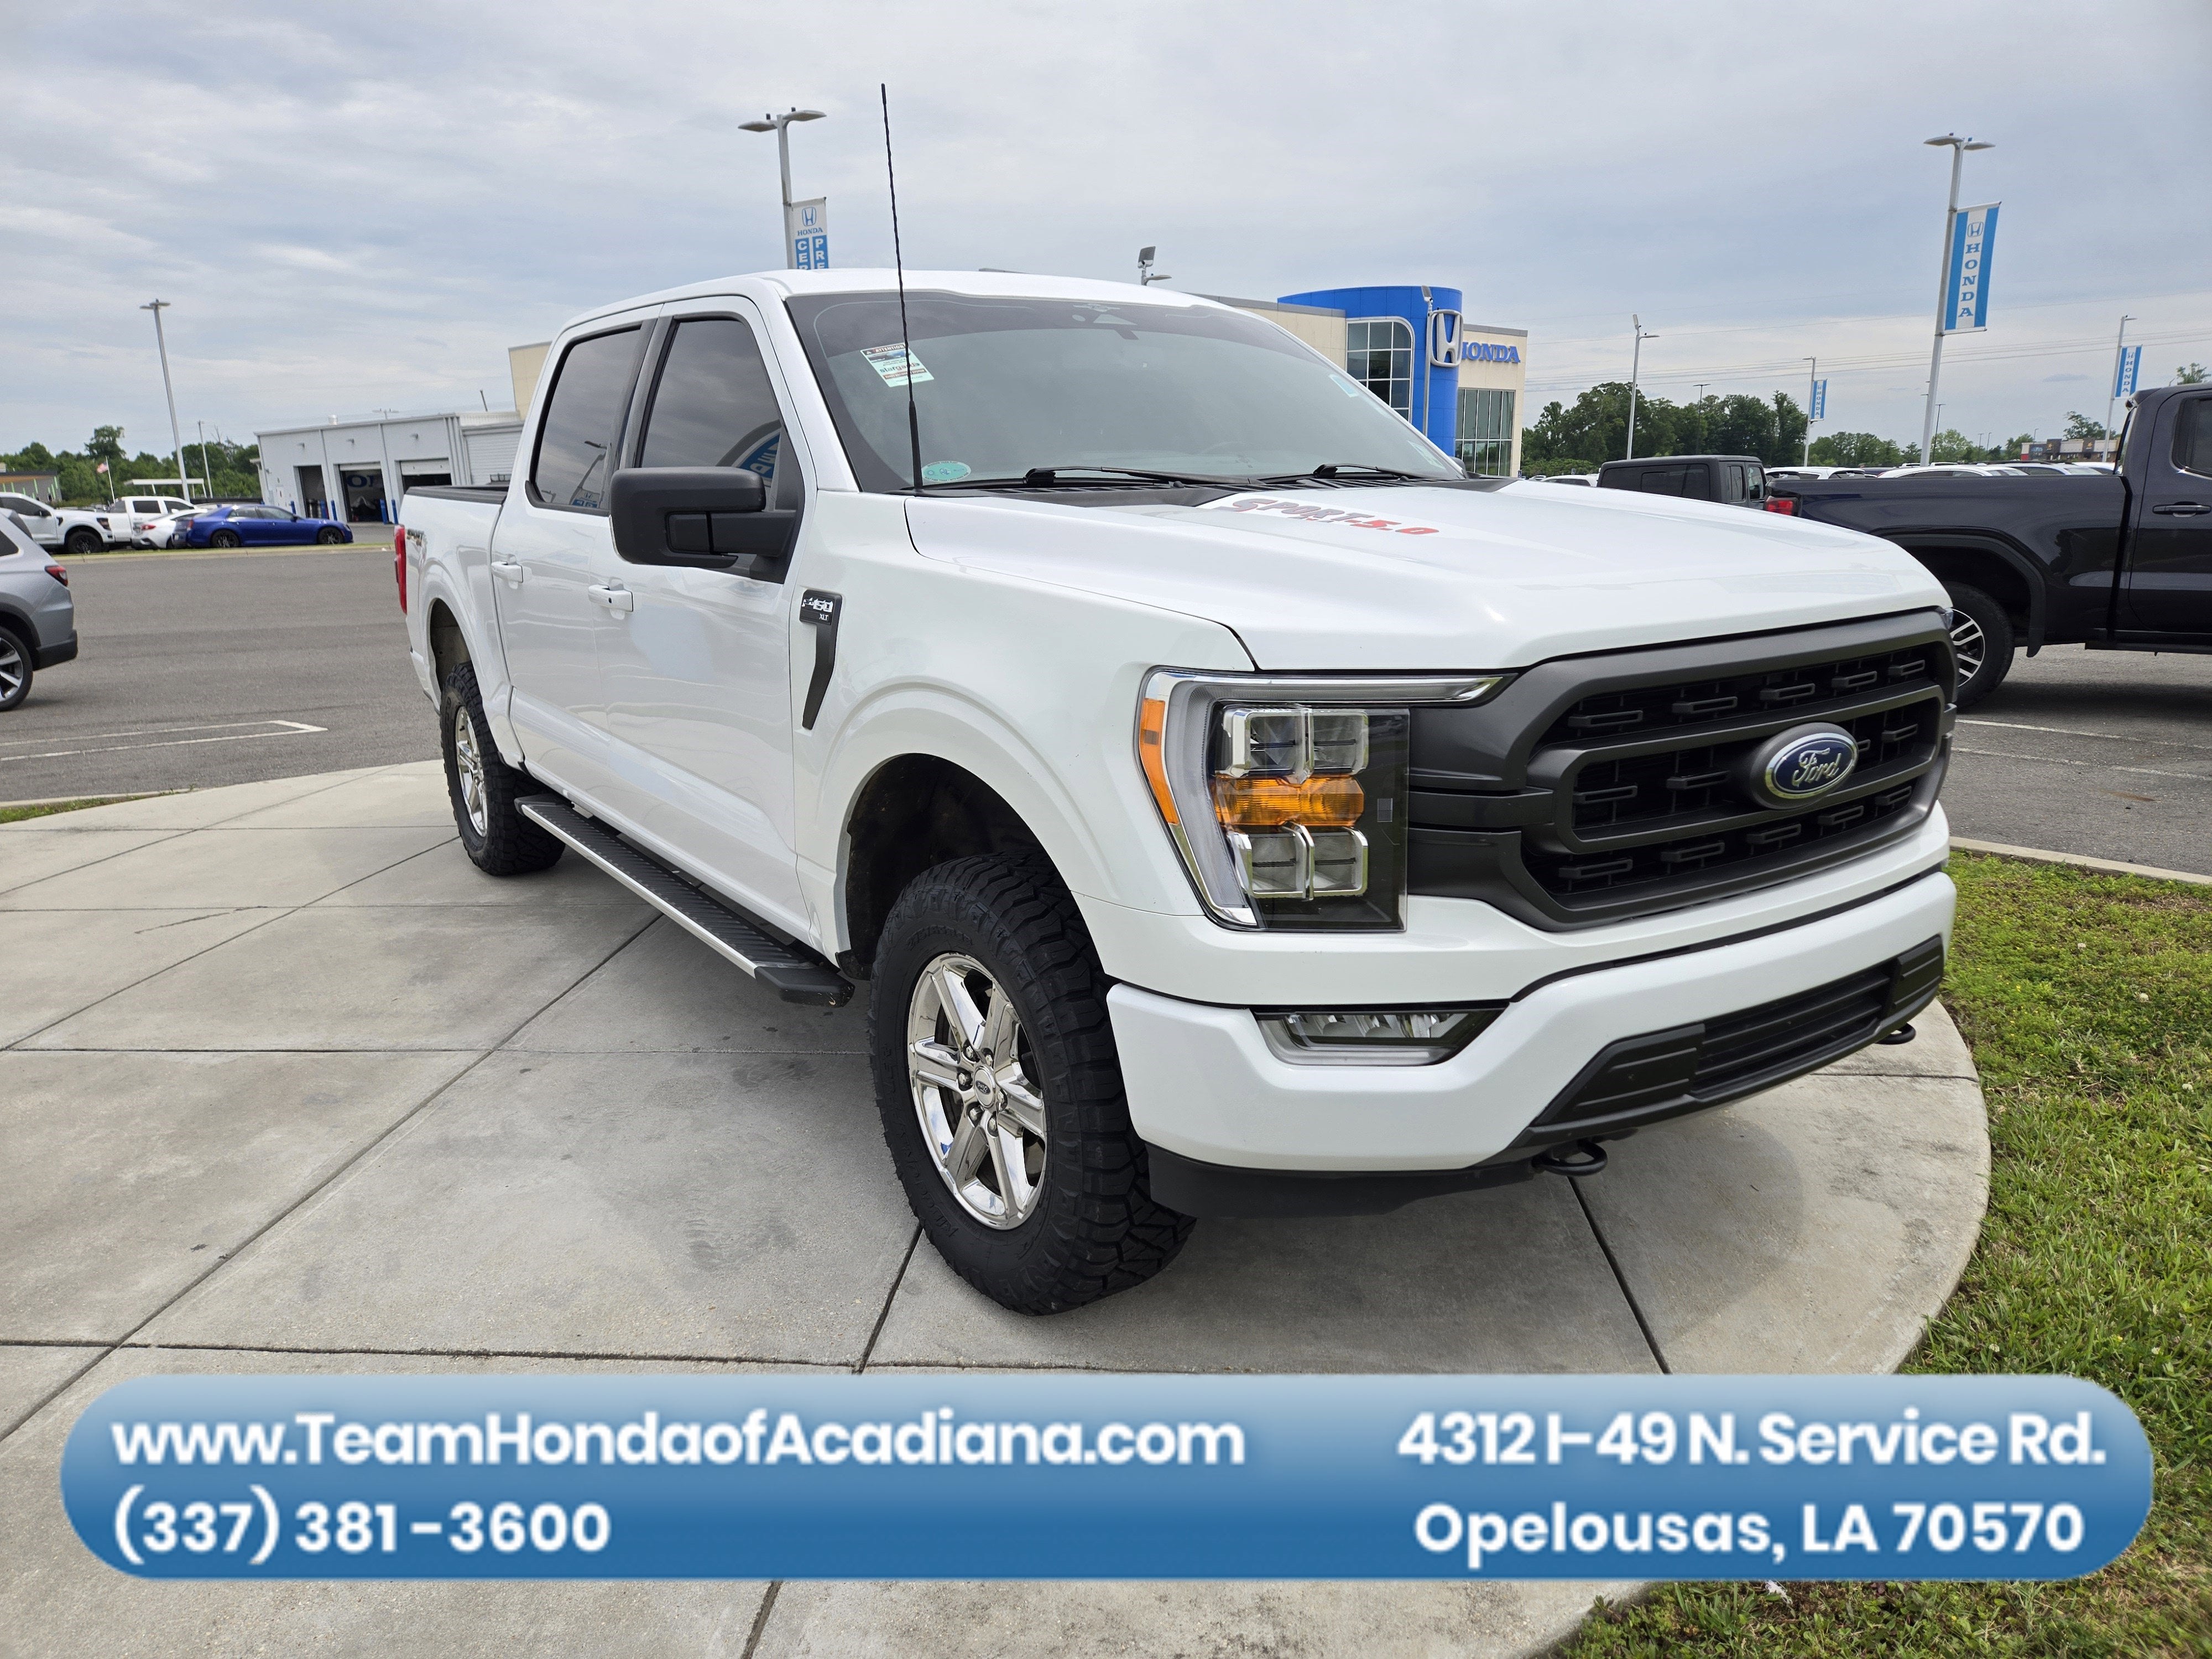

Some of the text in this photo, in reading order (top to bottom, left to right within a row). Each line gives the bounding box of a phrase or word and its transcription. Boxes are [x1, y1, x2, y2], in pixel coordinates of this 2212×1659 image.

[797, 227, 823, 236] HONDA
[1958, 243, 1980, 317] HONDA
[2122, 361, 2133, 392] HONDA
[1792, 747, 1842, 787] Ford
